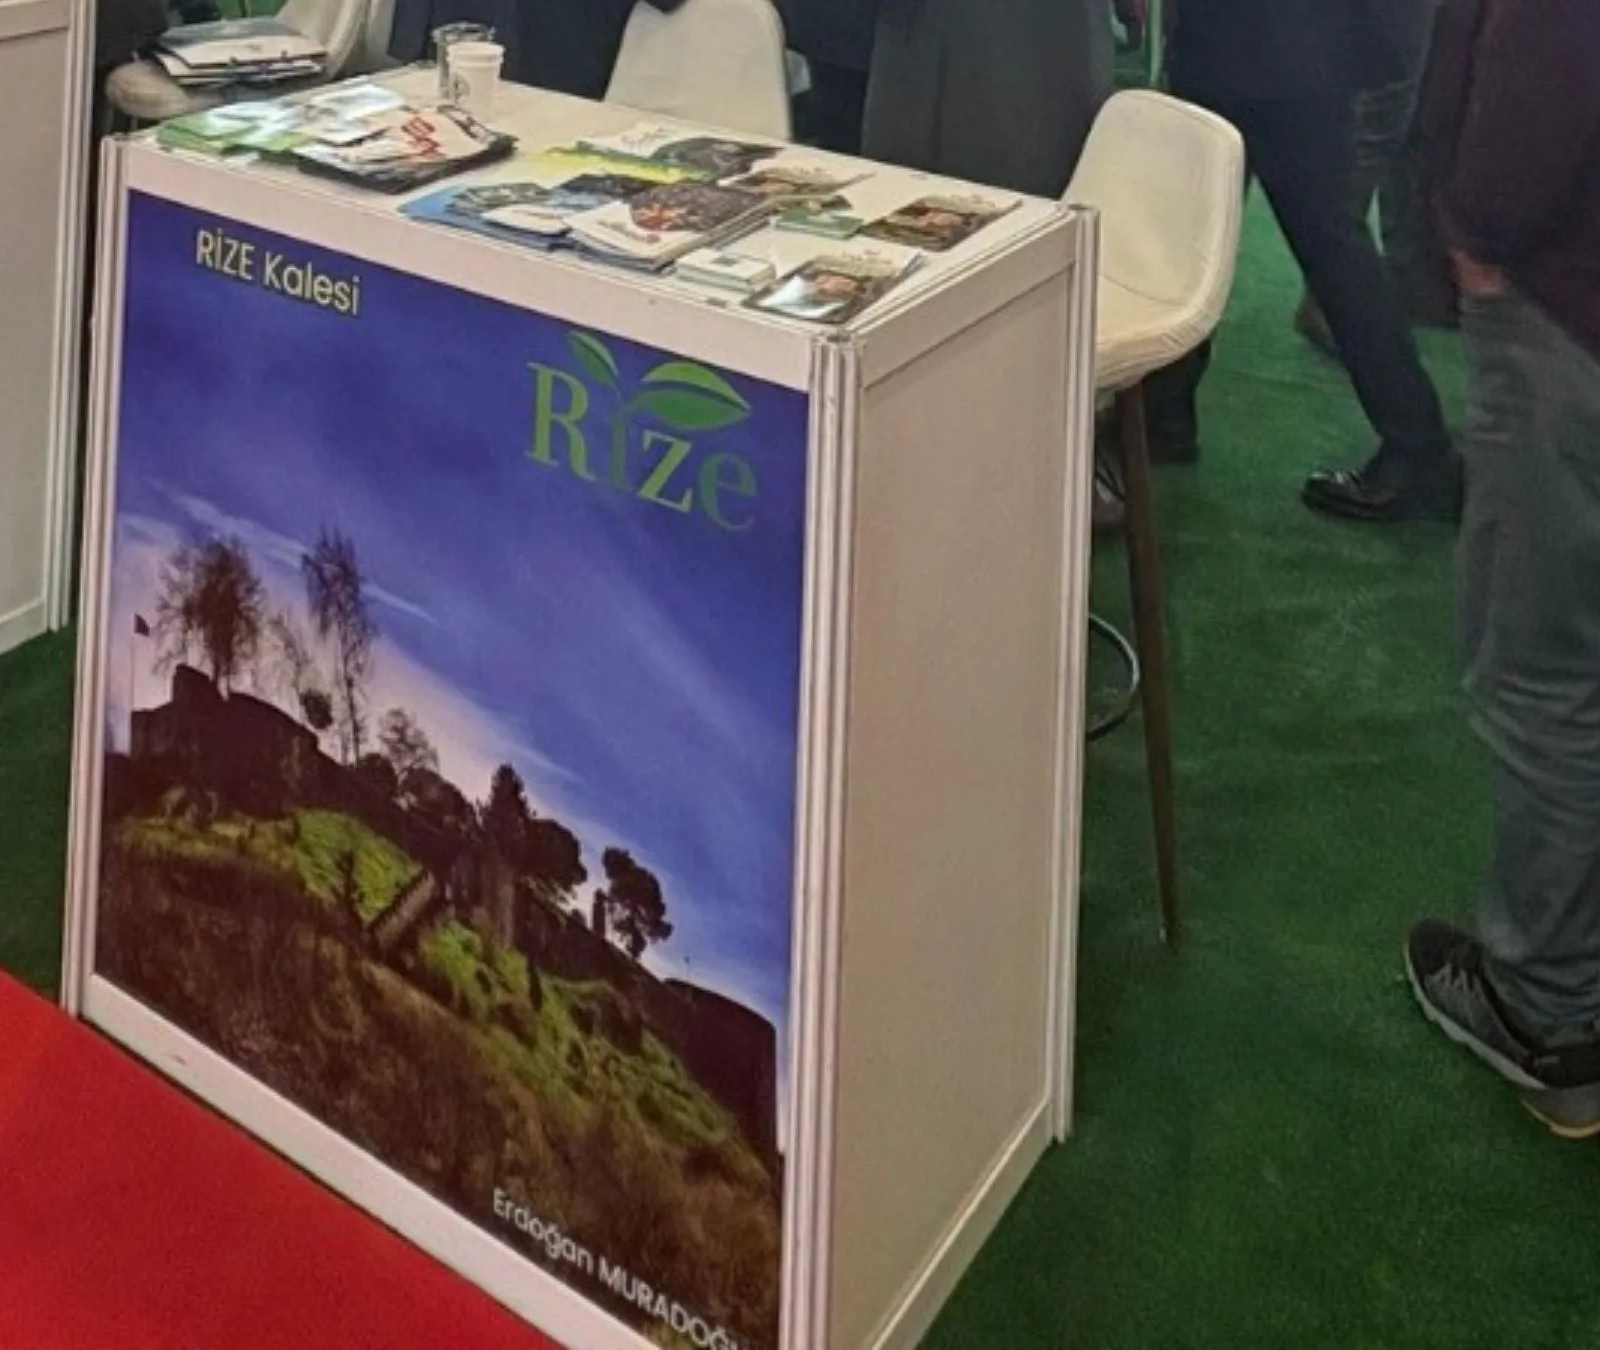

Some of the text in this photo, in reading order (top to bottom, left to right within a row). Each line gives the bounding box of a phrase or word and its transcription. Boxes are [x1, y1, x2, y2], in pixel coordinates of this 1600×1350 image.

[195, 227, 362, 317] RİZE Kalesi
[524, 361, 758, 533] Rize
[492, 1187, 594, 1276] Erdoğan
